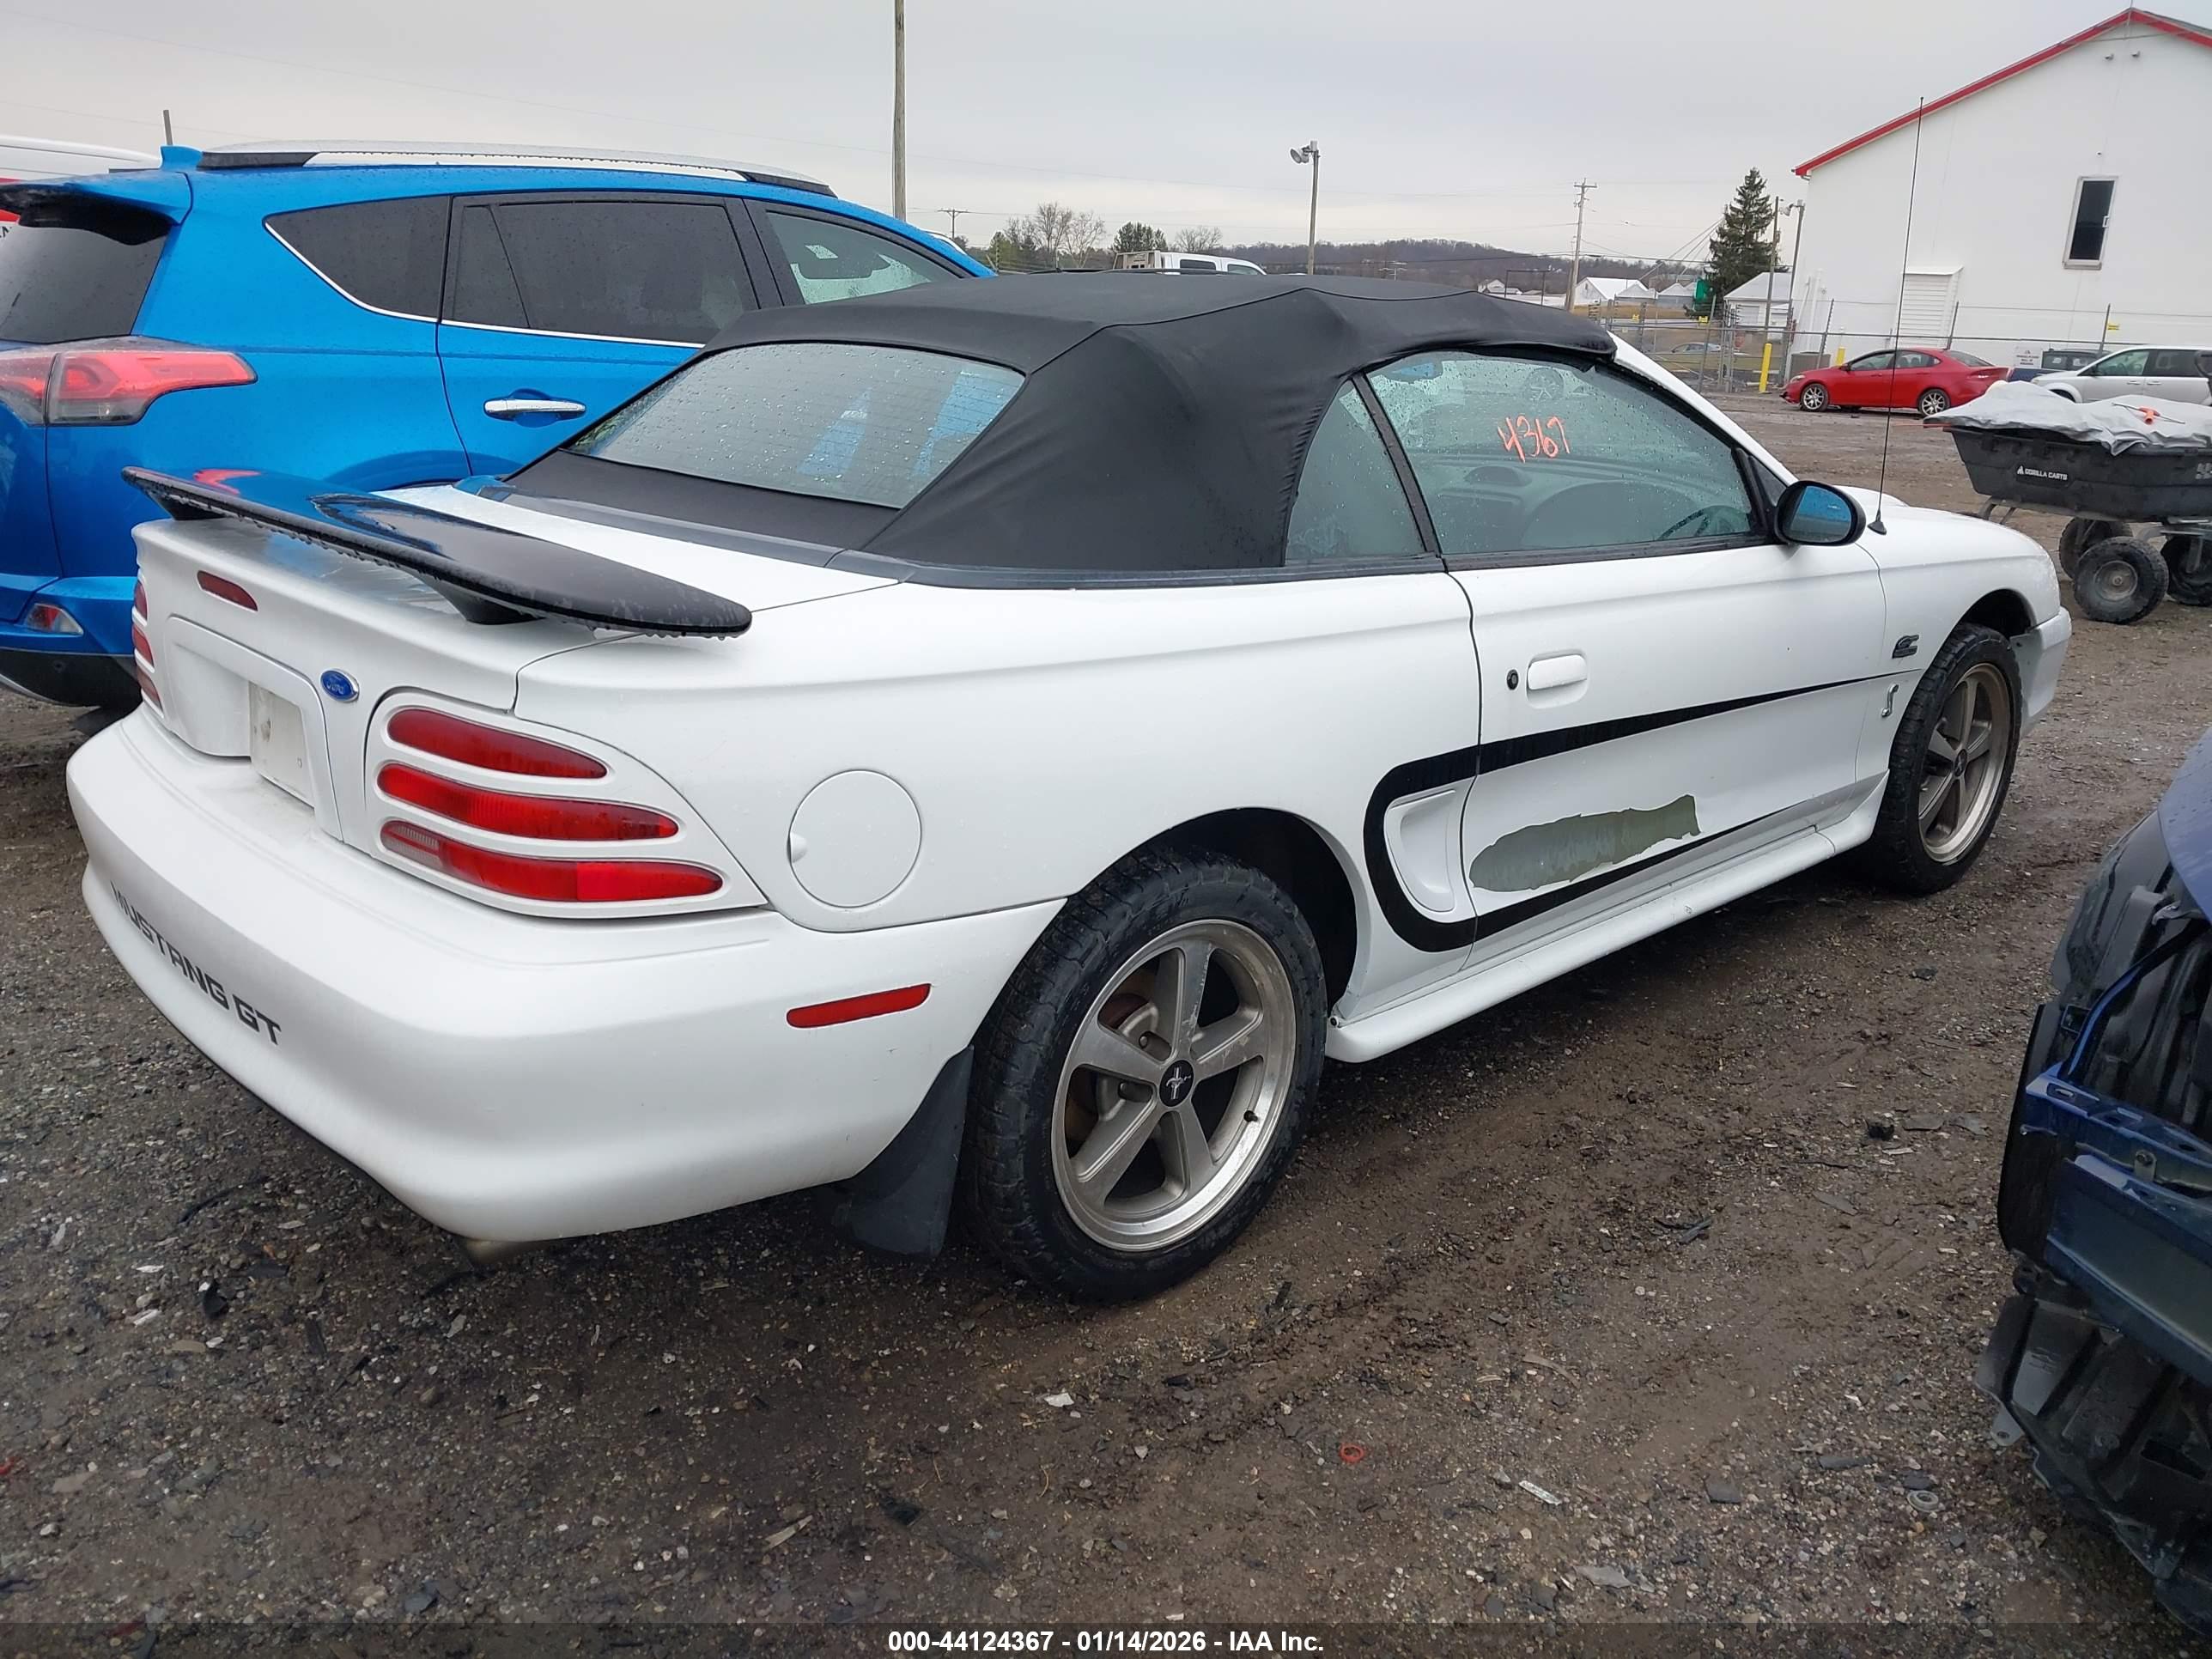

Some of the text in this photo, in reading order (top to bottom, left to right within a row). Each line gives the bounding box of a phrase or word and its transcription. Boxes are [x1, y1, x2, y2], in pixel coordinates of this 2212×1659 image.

[1497, 415, 1571, 464] 4367
[110, 879, 283, 1046] MUSTANG GT
